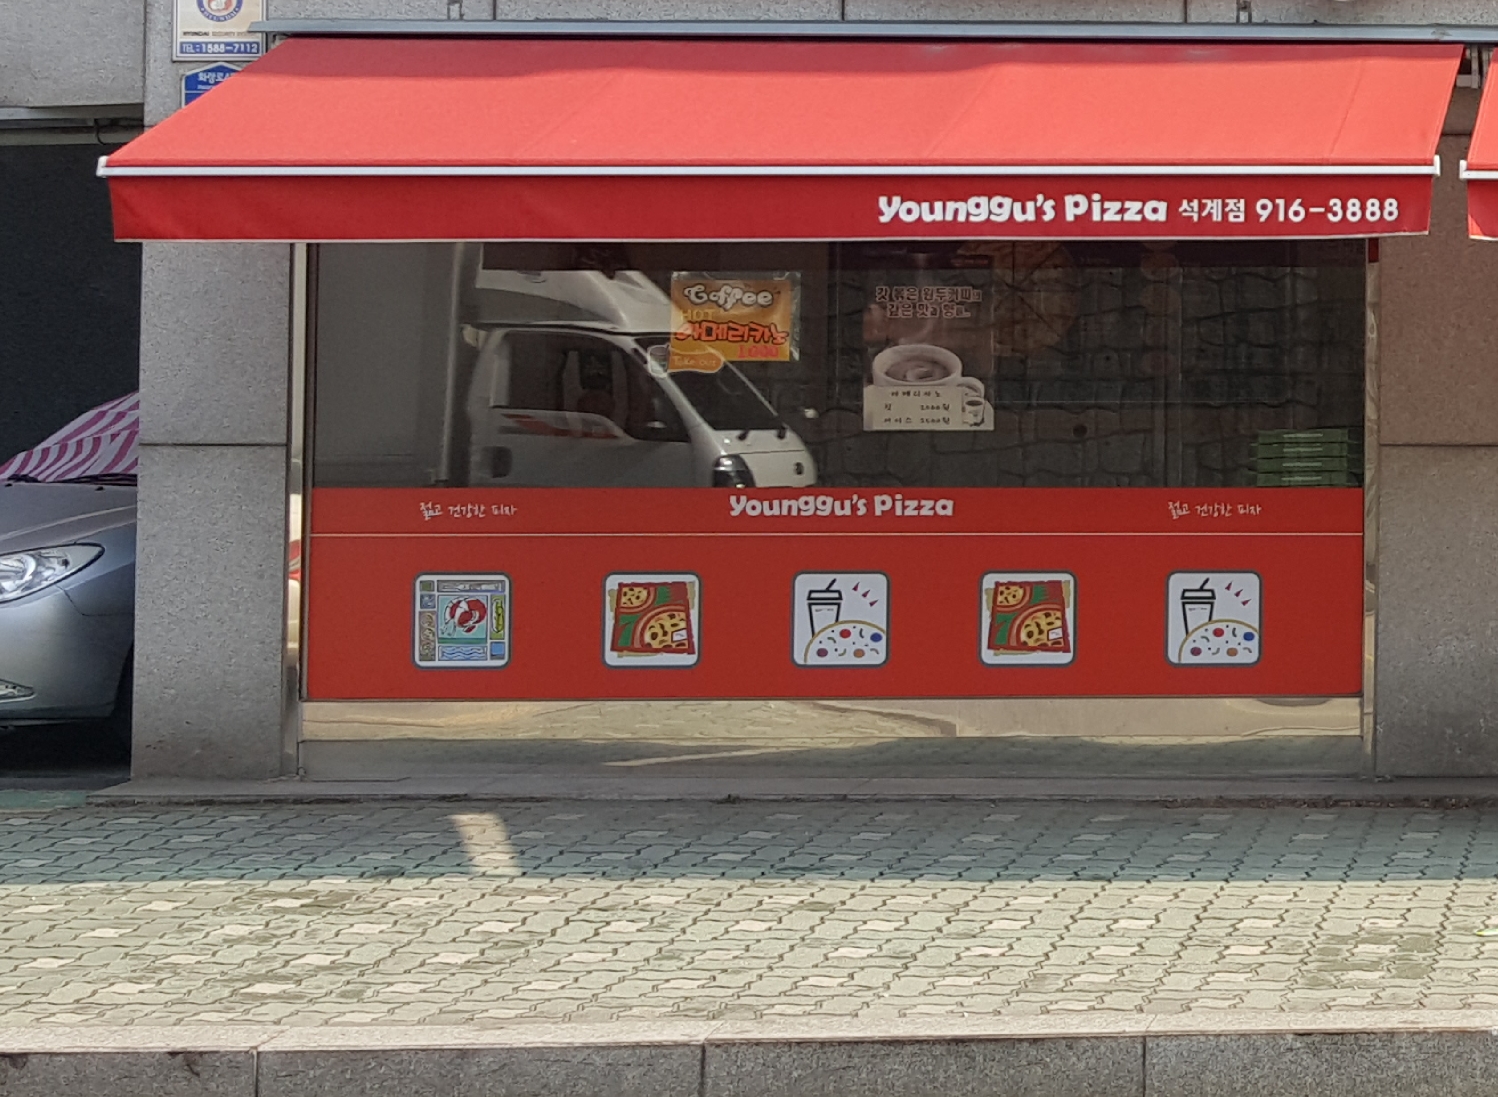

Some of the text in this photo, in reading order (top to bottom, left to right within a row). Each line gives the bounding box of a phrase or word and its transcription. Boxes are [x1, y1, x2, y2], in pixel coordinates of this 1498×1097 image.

[878, 192, 1400, 224] Younggu's Pizza 석계점 916-3888
[683, 283, 774, 312] Coffee
[674, 319, 790, 346] 아메리카노
[448, 503, 487, 519] 건강한
[491, 504, 519, 517] 피자
[729, 493, 955, 517] Younggu's Pizza
[1195, 502, 1233, 518] 건강한
[1237, 503, 1263, 517] 피자
